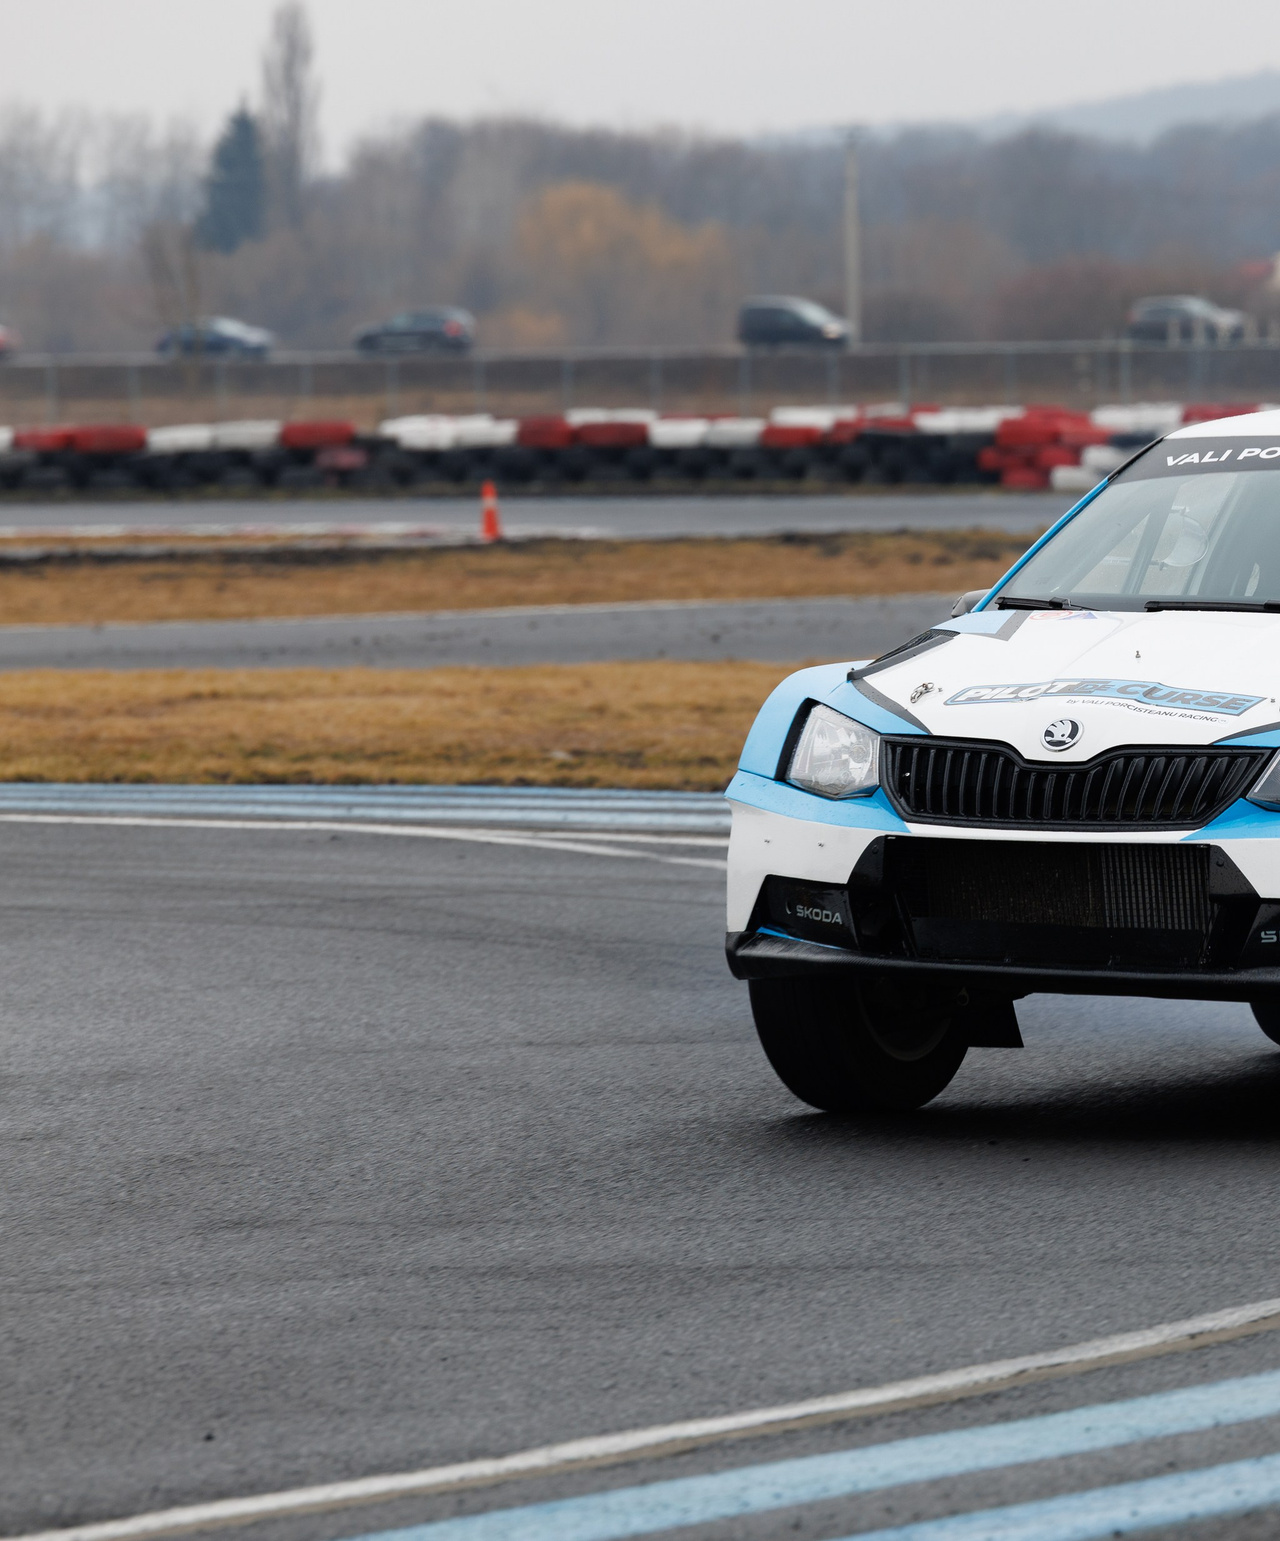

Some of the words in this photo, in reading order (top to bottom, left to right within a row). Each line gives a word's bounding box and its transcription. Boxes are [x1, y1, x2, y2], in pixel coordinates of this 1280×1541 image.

[1166, 449, 1233, 467] VALI
[954, 681, 1083, 701] PILOT
[1080, 683, 1116, 693] DE
[1116, 683, 1255, 711] CURSE
[1105, 701, 1178, 718] PORCISTEANU
[1178, 713, 1219, 723] RACING
[796, 904, 843, 925] SKODA
